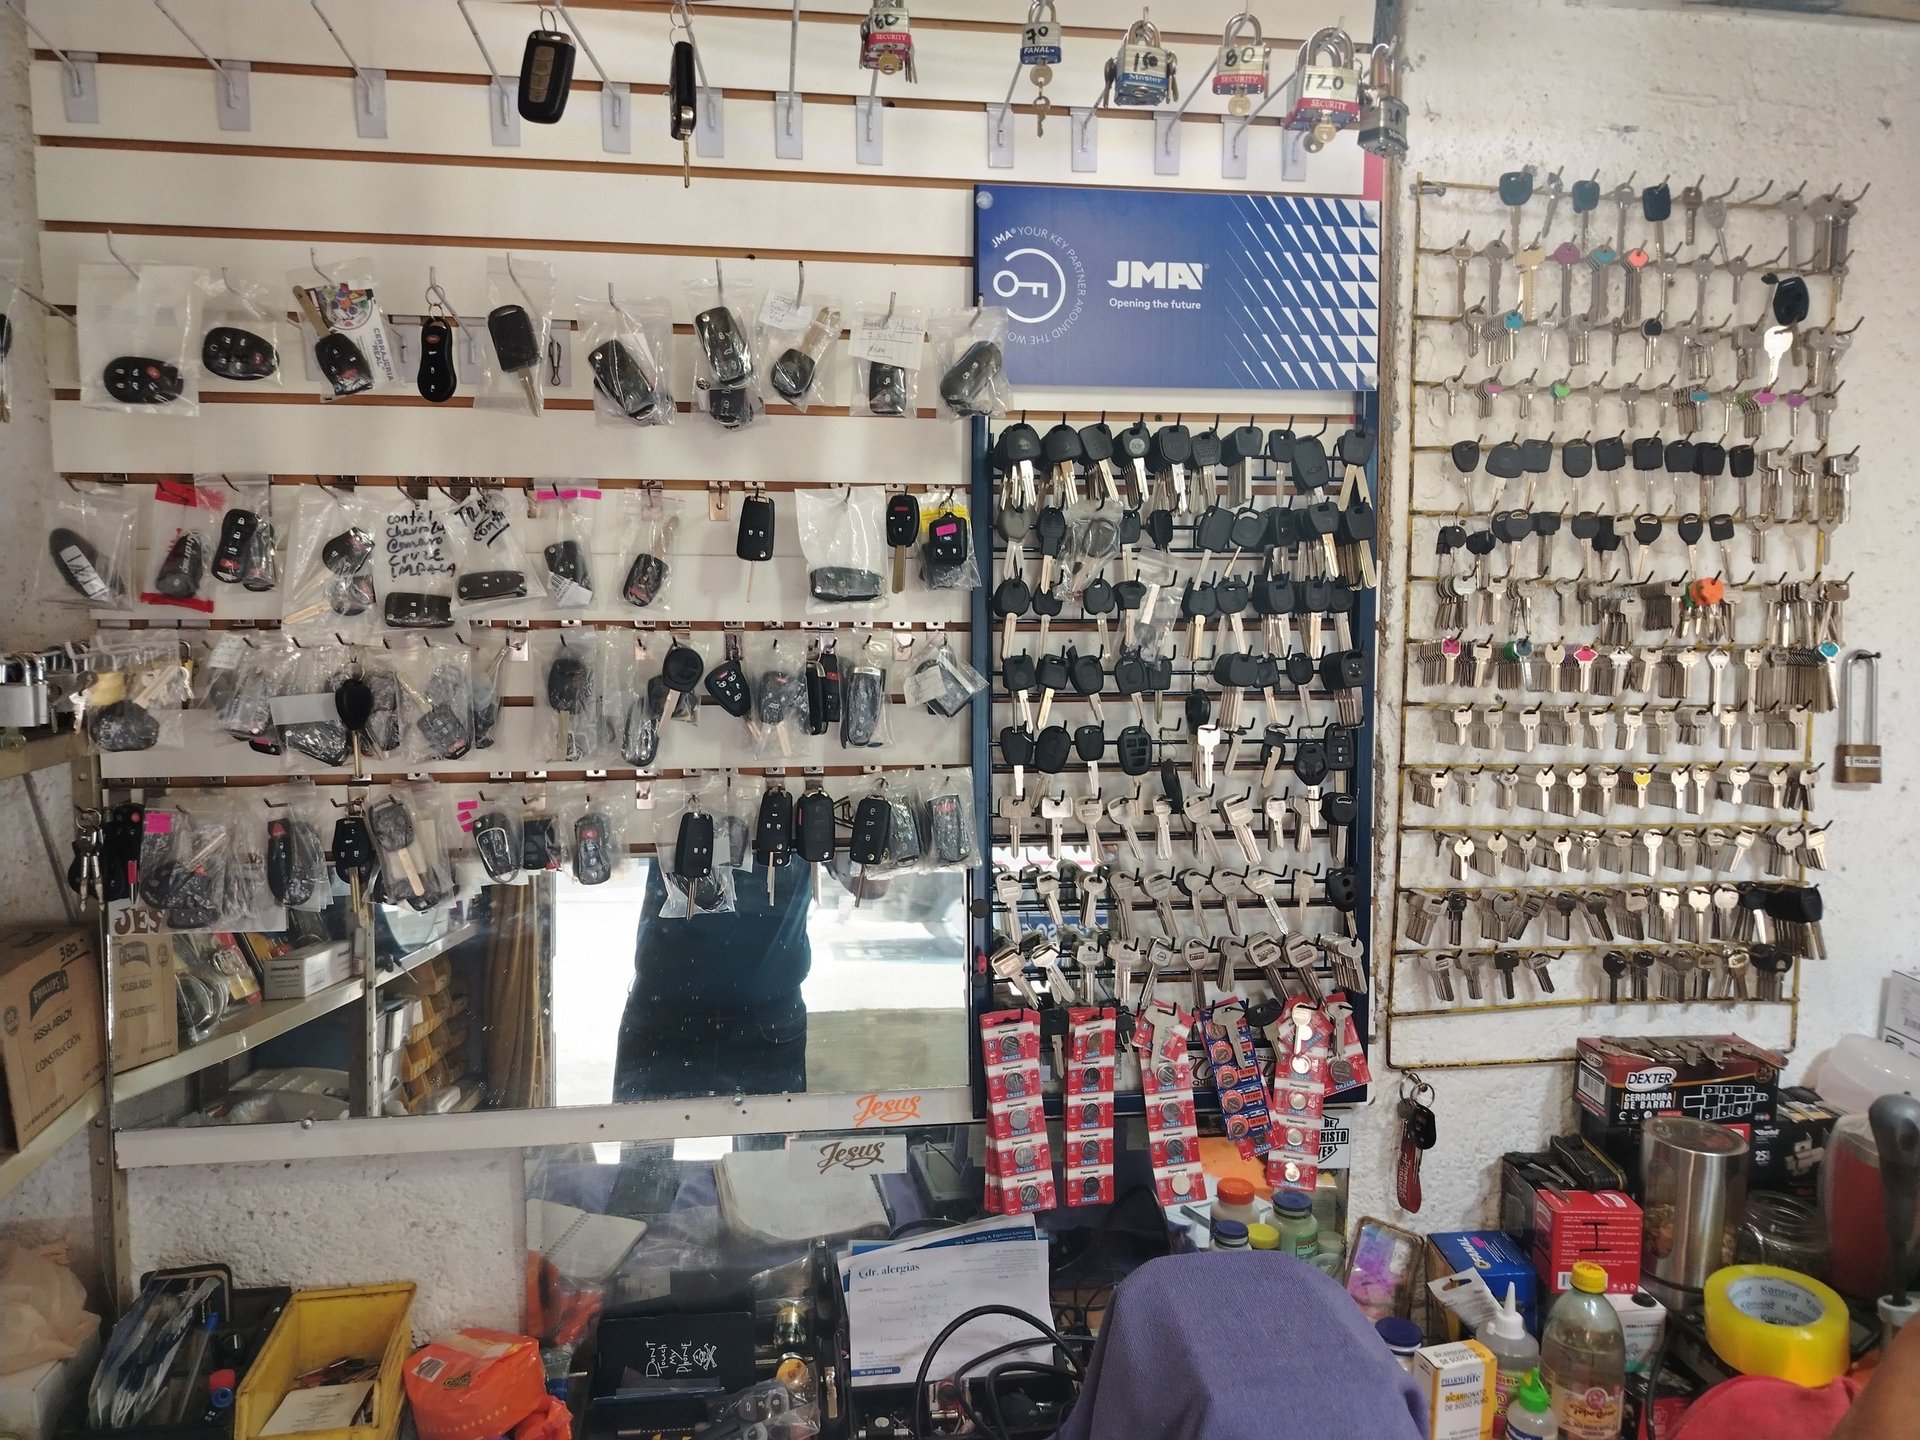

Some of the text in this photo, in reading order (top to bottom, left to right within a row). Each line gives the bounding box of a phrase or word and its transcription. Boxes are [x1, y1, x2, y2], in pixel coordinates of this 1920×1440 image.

[1026, 26, 1048, 44] 70
[1023, 46, 1050, 54] FANAL
[1129, 73, 1162, 83] Master
[1221, 75, 1258, 83] SECURITY
[1305, 73, 1344, 91] 120
[1310, 99, 1347, 110] SECURITY
[991, 230, 1013, 248] JMA
[1017, 227, 1048, 238] YOUR
[1050, 233, 1069, 249] KEY
[1067, 248, 1087, 296] PARTNER
[1107, 260, 1203, 290] JMA
[1109, 298, 1202, 311] Opening the future
[1052, 298, 1084, 338] AROUND
[1030, 334, 1050, 345] THE
[373, 327, 394, 381] CERRAJERIA
[114, 907, 165, 935] JES
[52, 1007, 73, 1030] ABLOY
[1628, 1072, 1672, 1085] DEXTER
[1624, 1092, 1672, 1102] CERRADURA
[853, 1093, 921, 1128] Jesus
[1624, 1101, 1672, 1110] DE BARRA
[1324, 1118, 1334, 1128] DE
[1321, 1131, 1346, 1142] RISTO
[817, 1142, 885, 1174] Jesus
[881, 1262, 920, 1275] alergias
